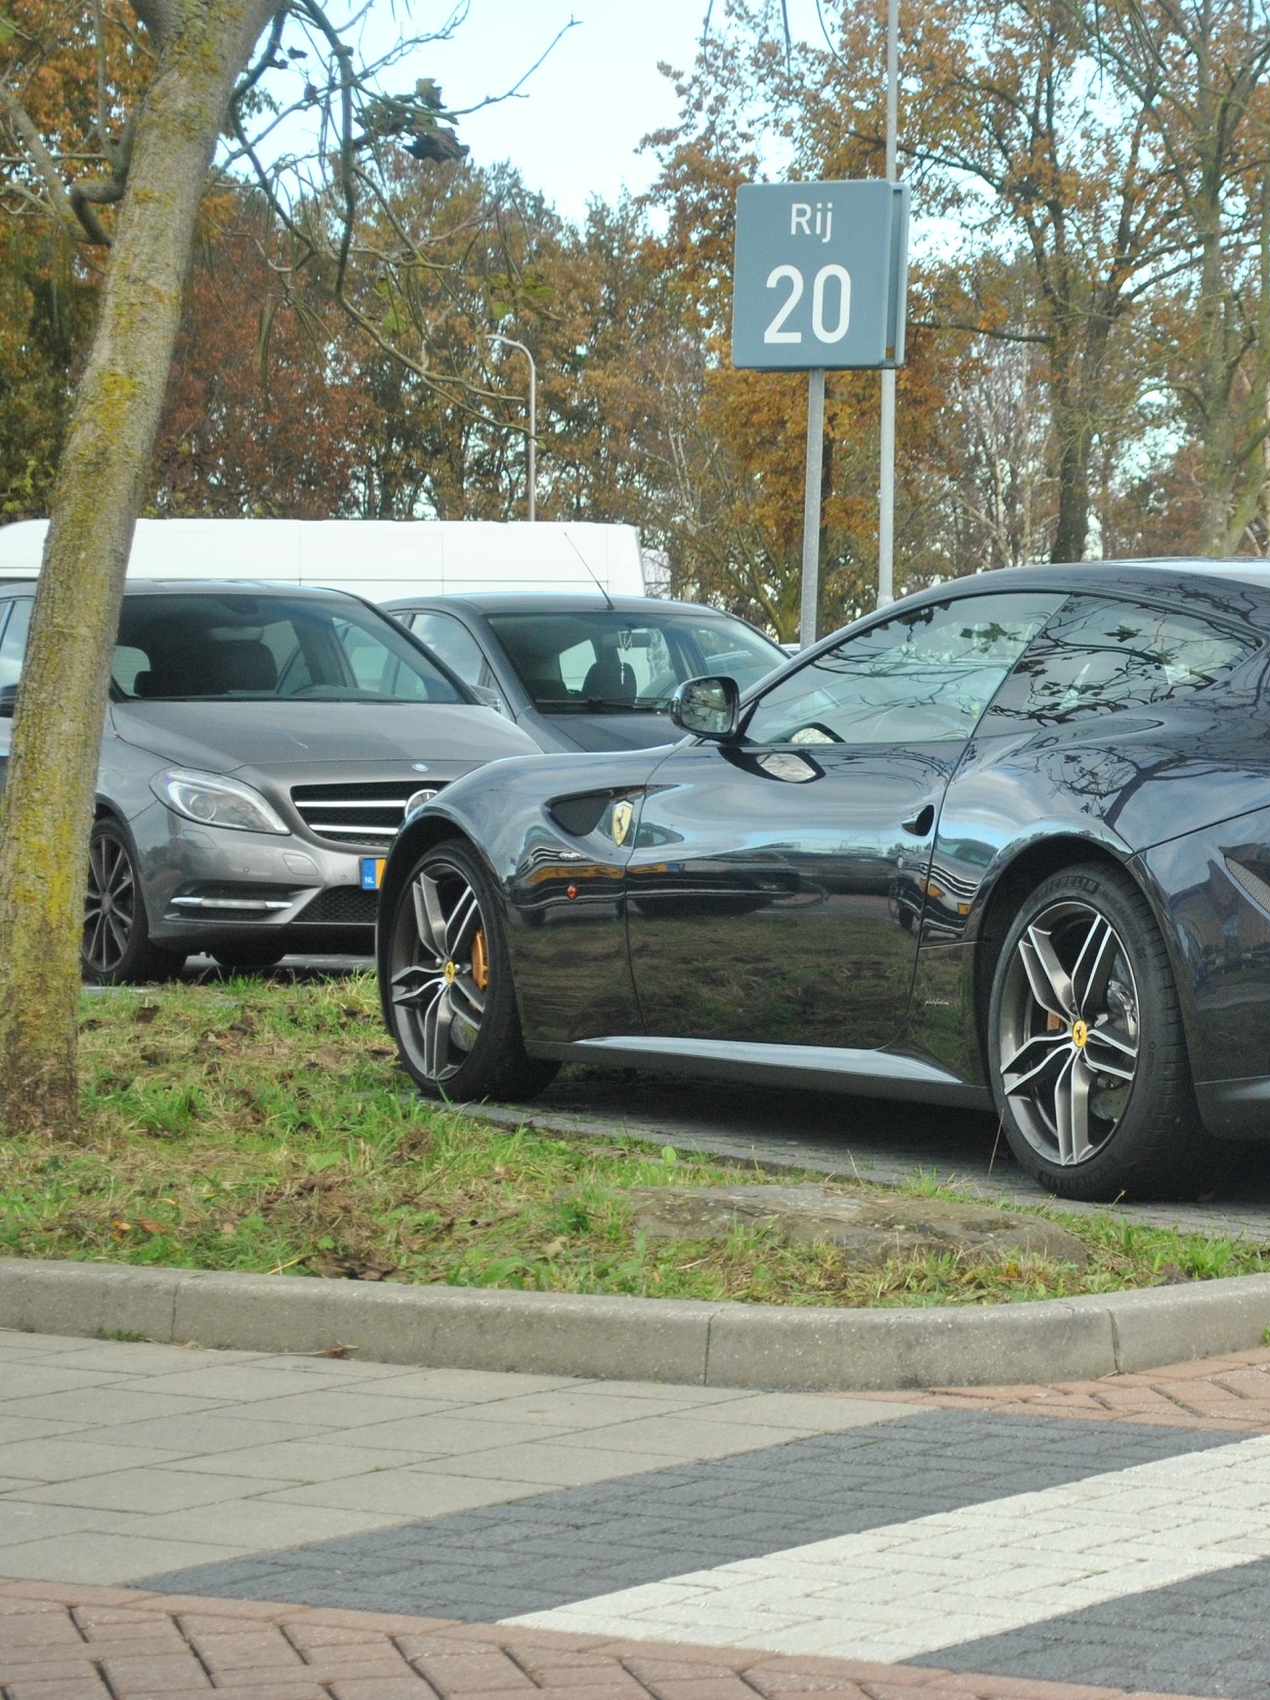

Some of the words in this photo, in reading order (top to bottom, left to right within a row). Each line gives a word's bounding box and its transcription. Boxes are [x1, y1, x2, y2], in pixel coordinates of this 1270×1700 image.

[790, 203, 833, 244] Rij
[763, 263, 852, 344] 20
[364, 876, 375, 884] NL
